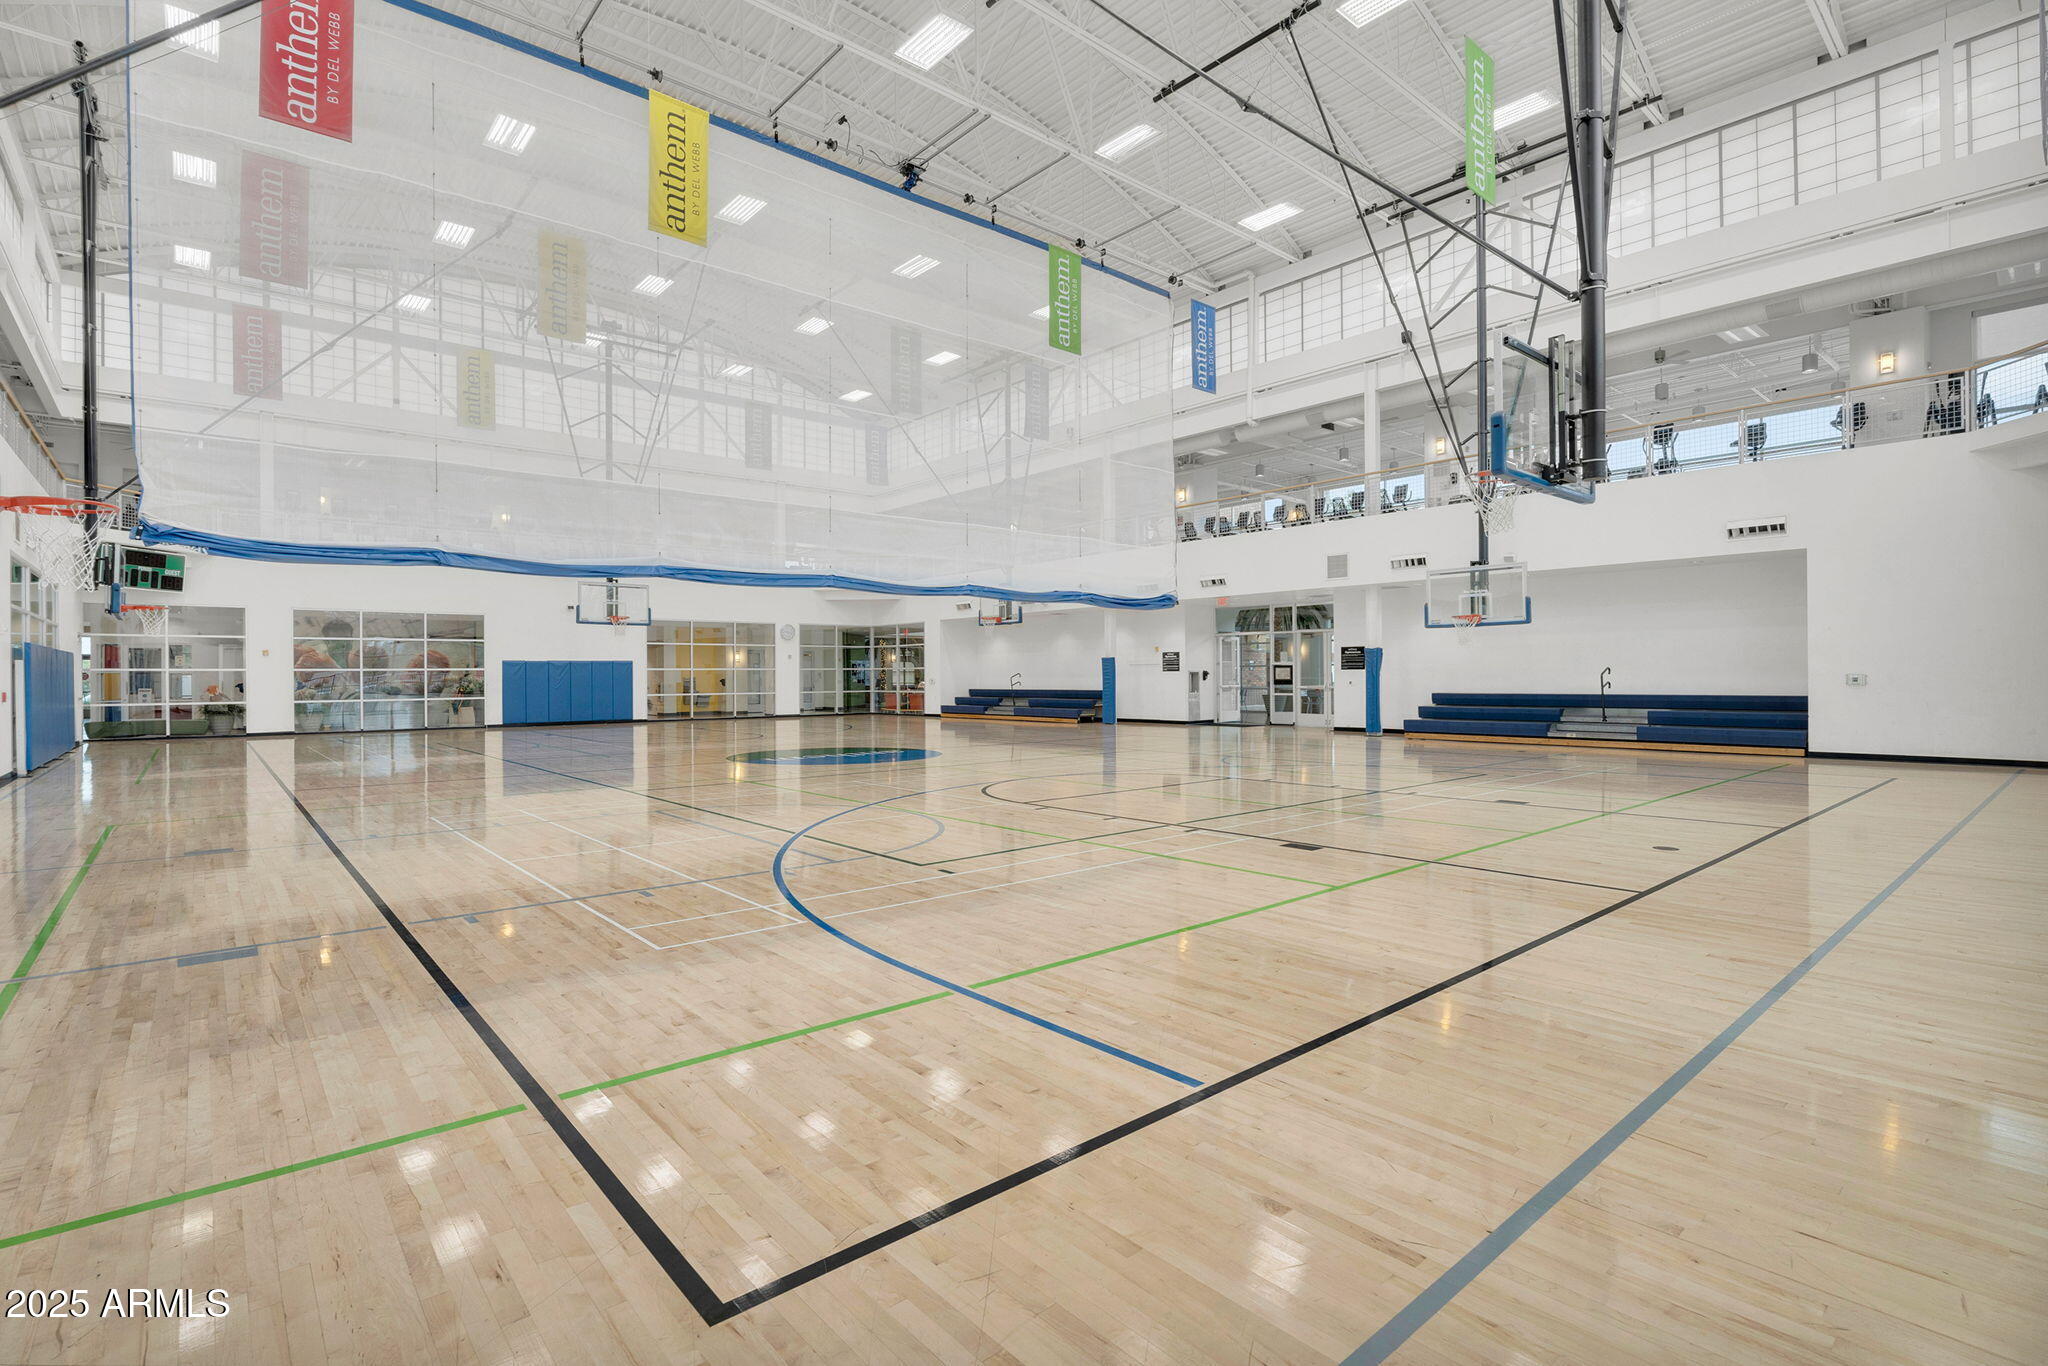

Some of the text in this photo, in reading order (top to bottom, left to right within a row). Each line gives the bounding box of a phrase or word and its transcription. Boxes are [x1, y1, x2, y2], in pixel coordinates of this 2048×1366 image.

[326, 11, 341, 104] BY DEL WEBB
[1471, 58, 1486, 191] anthem
[659, 111, 687, 233] anthem
[692, 142, 701, 217] BY DEL WEBB
[251, 167, 284, 278] anthem
[545, 242, 569, 335] anthem
[1055, 257, 1071, 347] anthem
[240, 315, 264, 393] anthem
[463, 356, 481, 425] anthem
[1195, 310, 1208, 388] anthem
